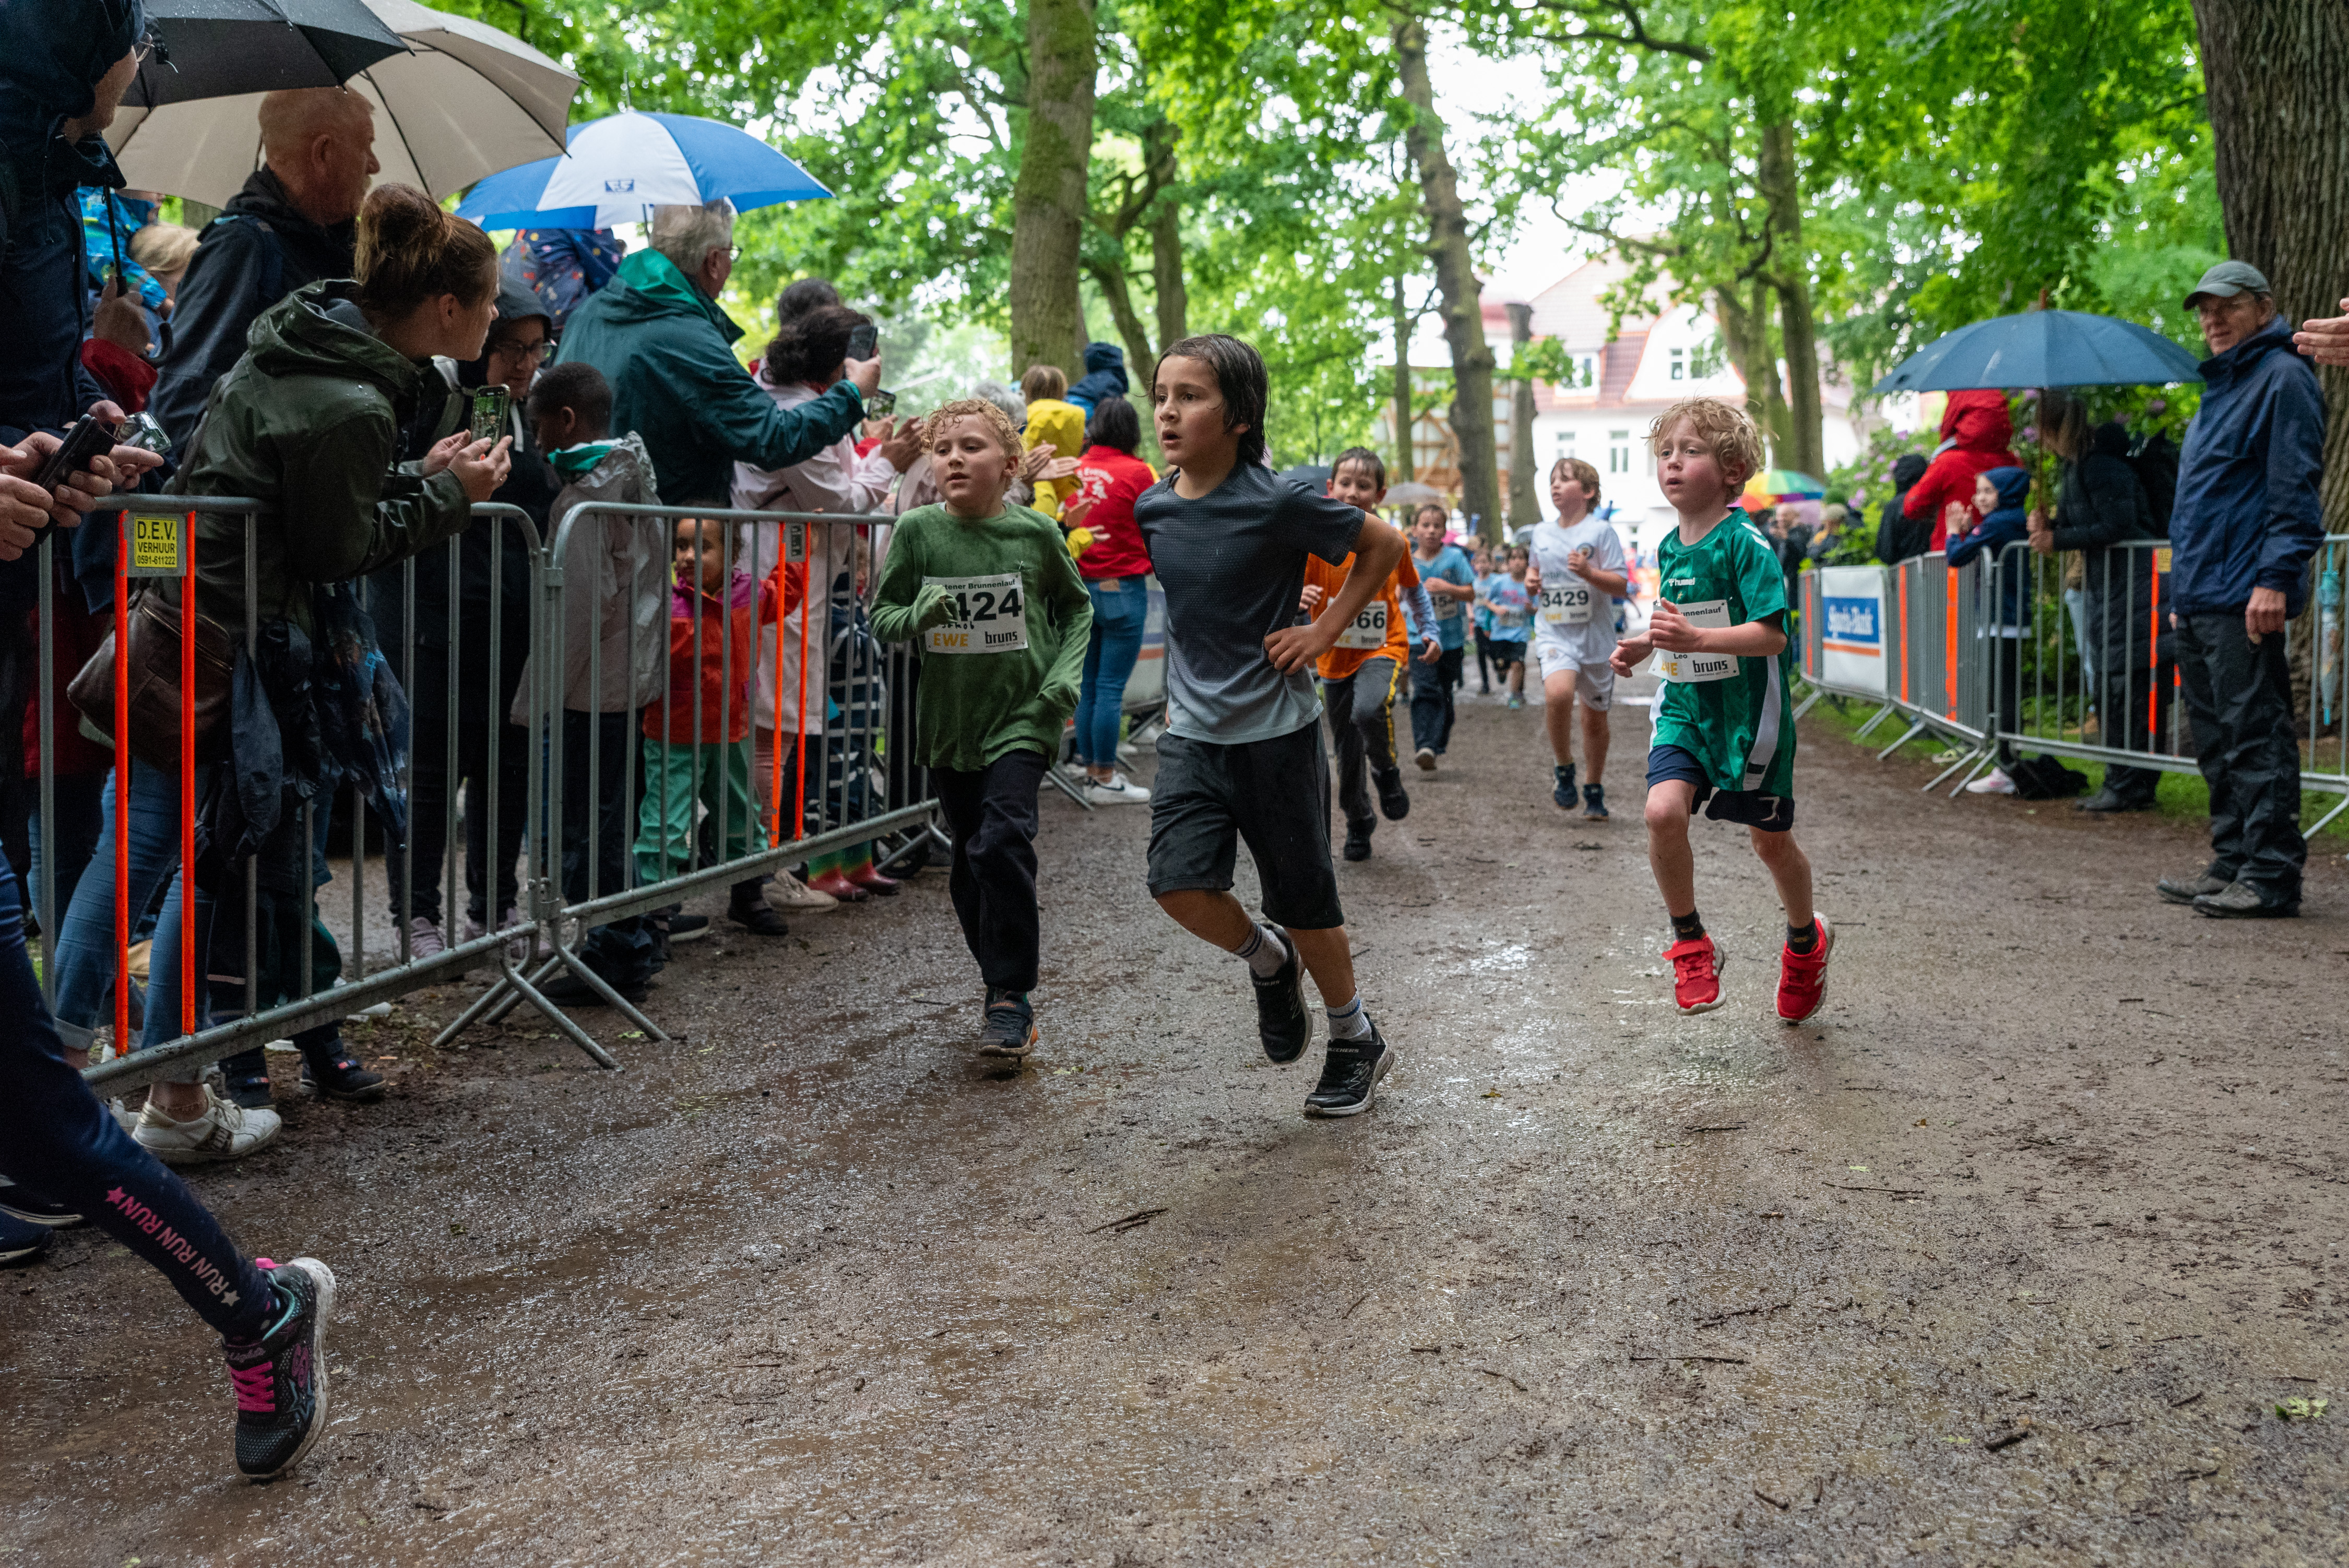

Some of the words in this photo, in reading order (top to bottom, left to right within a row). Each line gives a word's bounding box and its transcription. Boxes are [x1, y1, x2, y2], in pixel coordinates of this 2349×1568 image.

[137, 521, 175, 540] D.E.V.
[137, 542, 175, 553] VERHUUR
[137, 555, 175, 565] 0591-611222
[968, 579, 1016, 589] Brunnenlauf
[1541, 590, 1589, 608] 3429
[1681, 607, 1722, 616] unnenlauf
[1349, 611, 1385, 629] 66
[933, 633, 969, 647] EWE
[985, 631, 1018, 644] bruns
[1692, 660, 1728, 673] bruns
[116, 1196, 164, 1234] RUN
[156, 1227, 198, 1263] RUN
[190, 1257, 230, 1296] RUN
